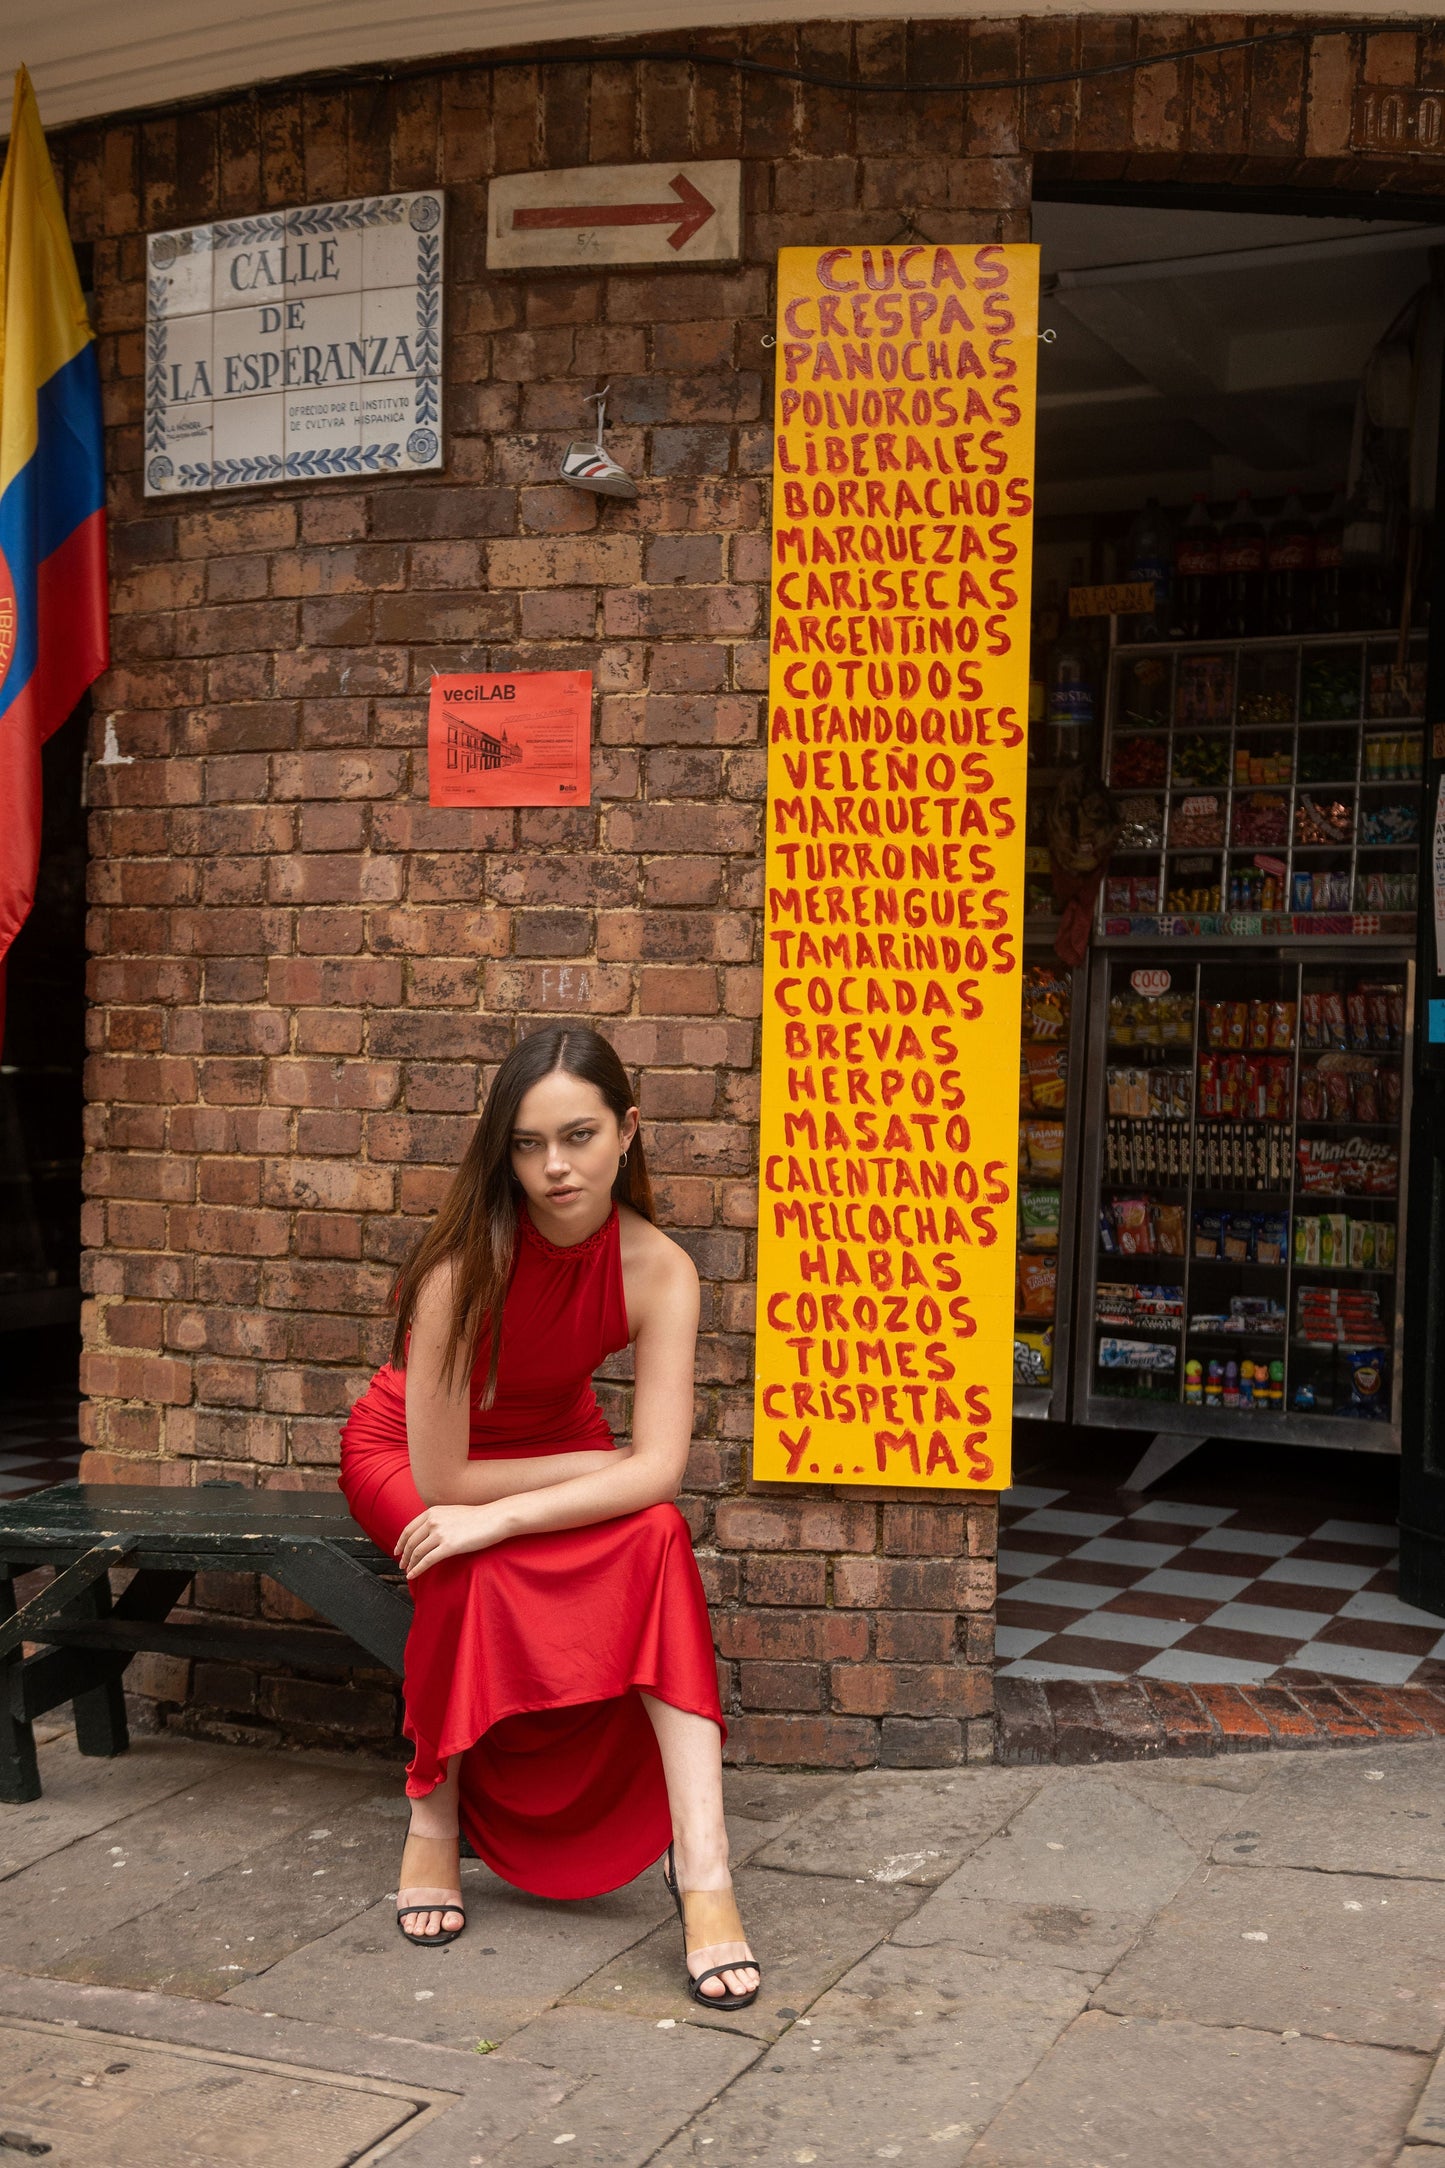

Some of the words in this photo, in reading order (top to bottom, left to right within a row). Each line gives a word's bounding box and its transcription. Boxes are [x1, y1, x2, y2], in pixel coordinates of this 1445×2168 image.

[230, 238, 340, 291] CALLE
[817, 246, 1008, 292] CUCAS
[259, 302, 305, 334] DE
[785, 292, 1015, 339] CRESPAS
[170, 360, 213, 401] LA
[224, 336, 418, 394] ESPERANZA
[784, 339, 1016, 383] PANOCHAS
[289, 404, 328, 417] OFRECIDO
[331, 402, 346, 413] POR
[350, 401, 360, 412] EL
[290, 421, 301, 431] DE
[354, 413, 405, 425] HISPANICA
[781, 385, 1020, 429] POLVOROSAS
[784, 478, 1031, 521] BORRACHOS
[777, 524, 1017, 565] MARQUEZAS
[443, 684, 516, 701] veciLAB
[784, 661, 983, 701] COTUDOS
[772, 704, 1023, 747] ALFANDOQUES
[784, 747, 993, 793] VELEÑOS
[775, 797, 1015, 838] MARQUETAS
[776, 843, 994, 883] TURRONES
[770, 886, 1008, 929] MERENGUES
[775, 977, 983, 1020] COCADAS
[1132, 970, 1169, 988] COCO
[785, 1022, 957, 1064] BREVAS
[789, 1067, 965, 1110] HERPOS
[785, 1110, 970, 1152] MASATO
[766, 1156, 1009, 1204] CALENTANOS
[774, 1200, 997, 1246] MELCOCHAS
[800, 1246, 961, 1291] HABAS
[768, 1293, 976, 1337] COROZOS
[786, 1337, 955, 1381] TUMES
[874, 1428, 994, 1482] MAS
